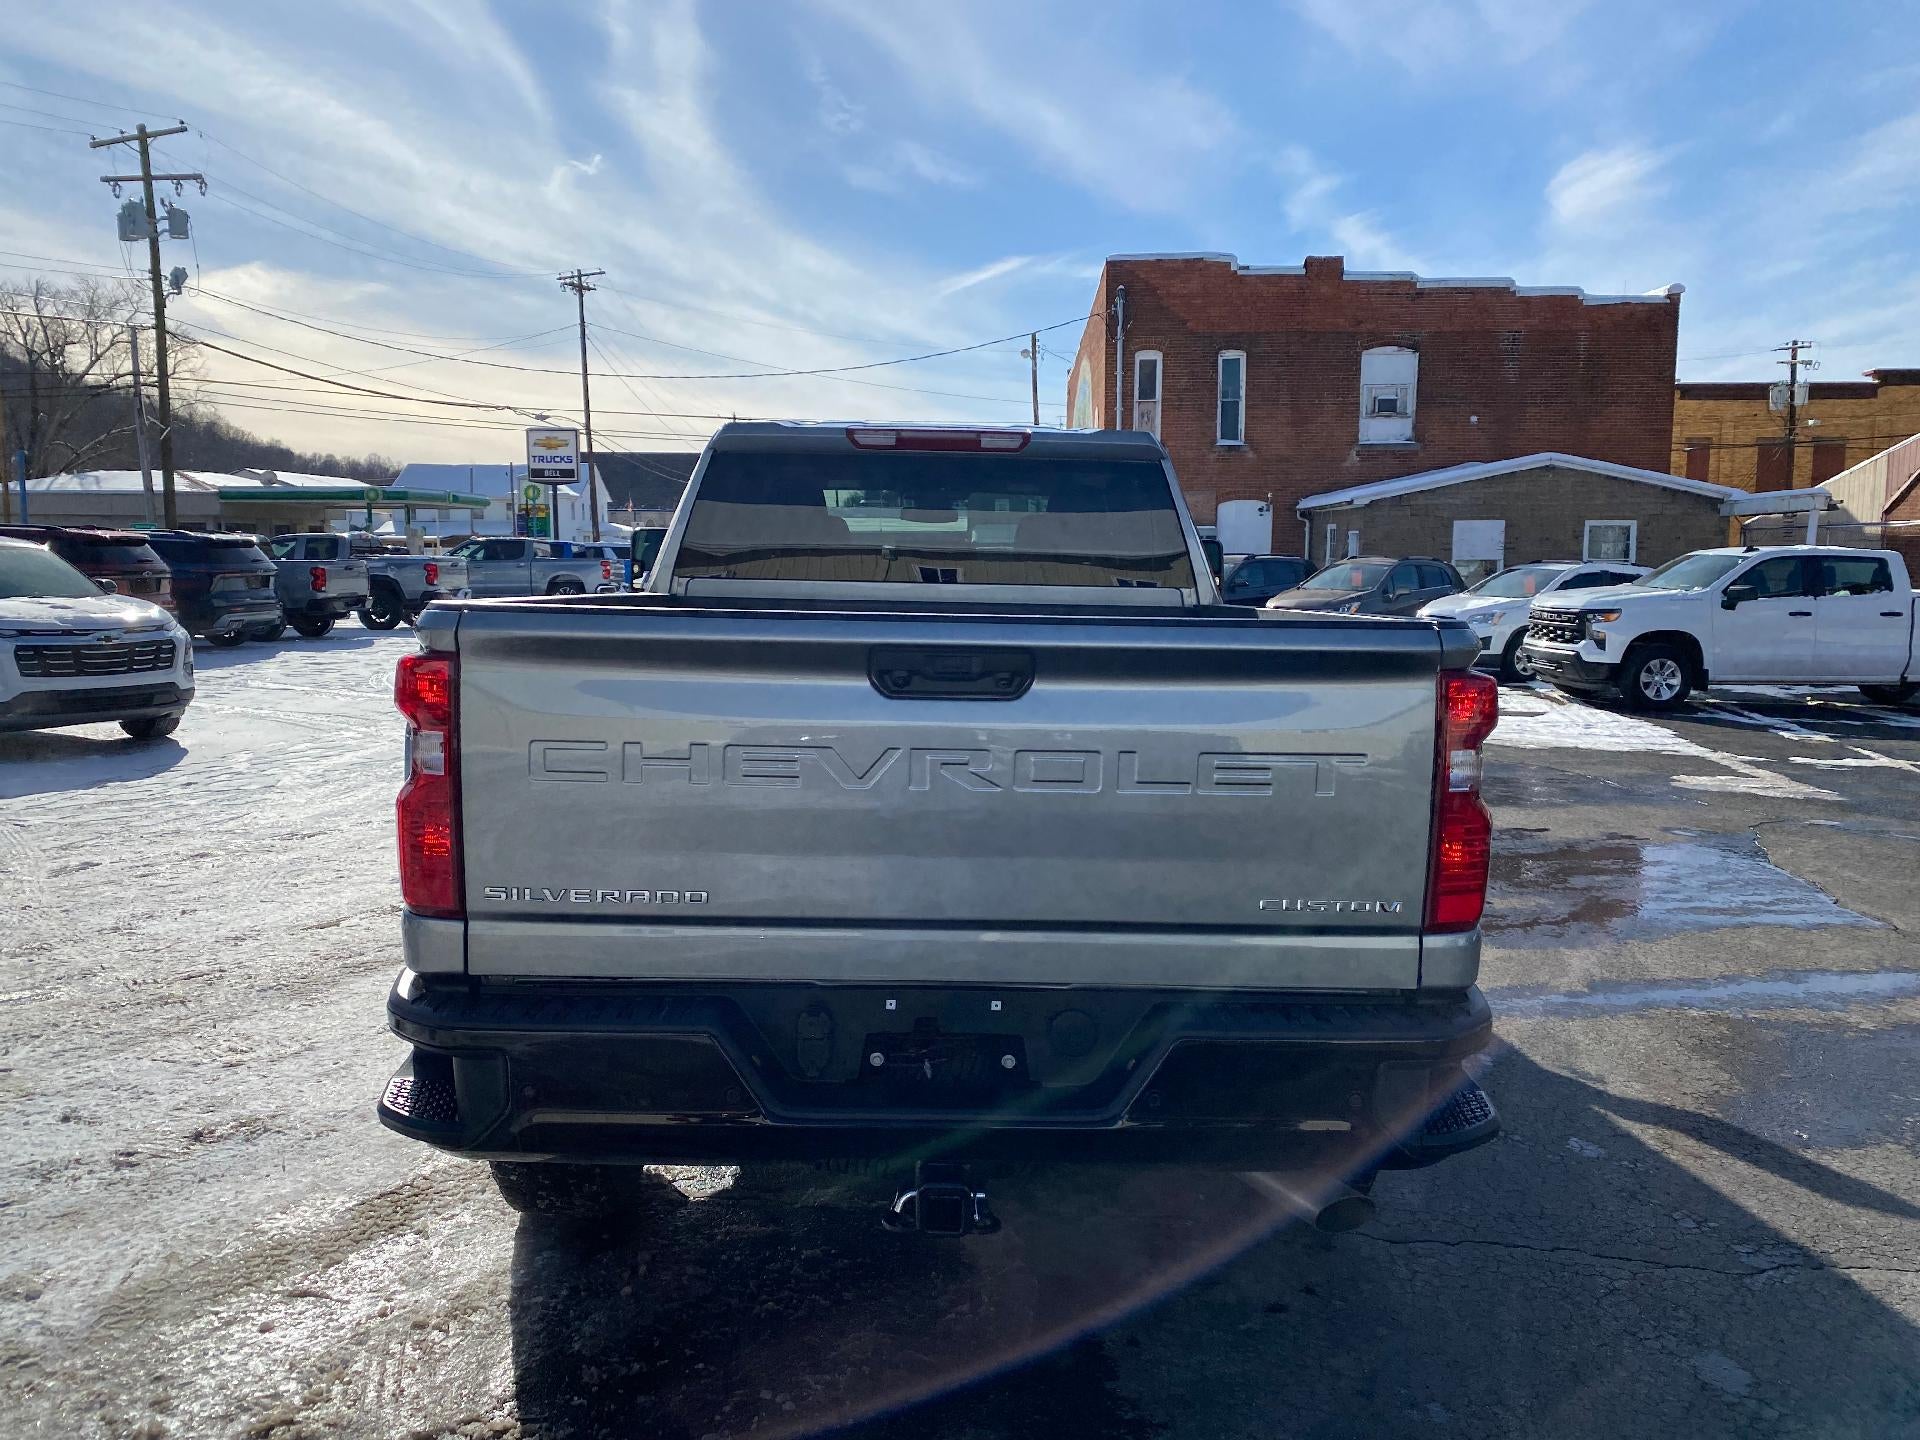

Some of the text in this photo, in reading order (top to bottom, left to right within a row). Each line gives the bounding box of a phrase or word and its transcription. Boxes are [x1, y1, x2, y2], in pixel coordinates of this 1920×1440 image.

[531, 455, 573, 464] TRUCKS
[529, 739, 1369, 796] CHEVROLET
[484, 886, 709, 904] SILVERADO
[1259, 898, 1403, 913] CUSTOM
